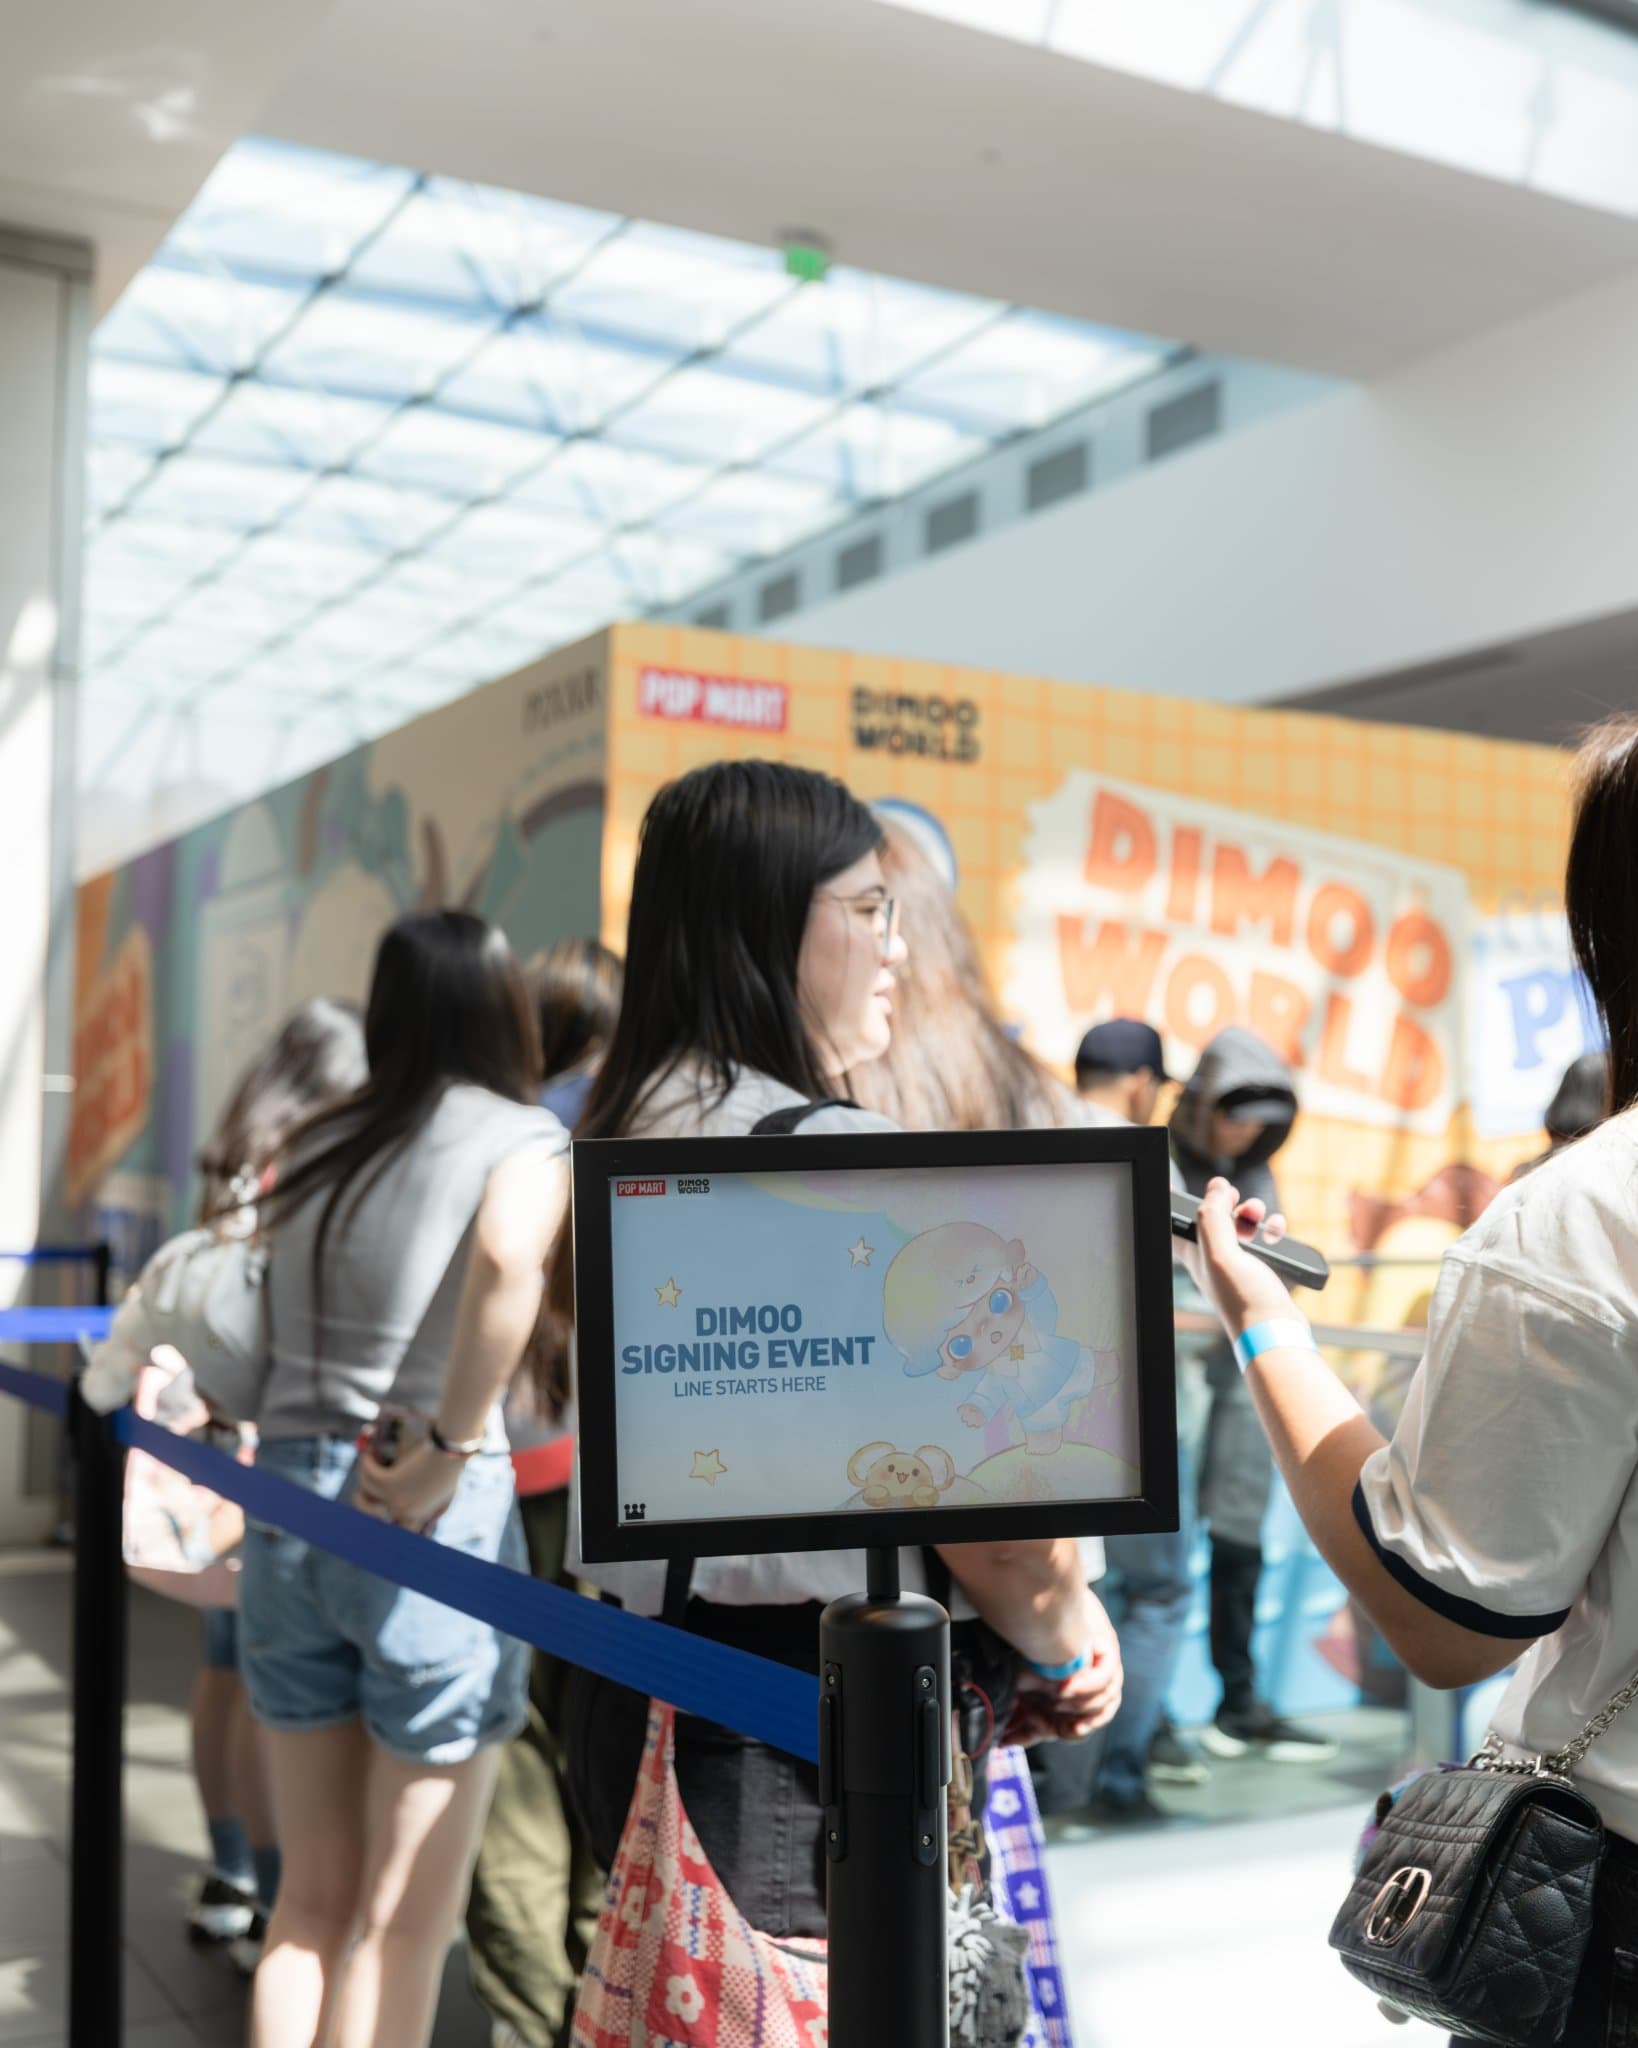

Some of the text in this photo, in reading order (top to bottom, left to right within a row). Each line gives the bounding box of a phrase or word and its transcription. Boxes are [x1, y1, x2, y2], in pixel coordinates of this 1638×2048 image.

[643, 668, 784, 729] POP MART
[853, 686, 978, 726] DIMOO
[855, 725, 980, 763] WORLD
[1083, 788, 1452, 1009] DIMOO
[618, 1182, 664, 1194] POP MART
[678, 1186, 710, 1194] WORLD
[695, 1304, 802, 1337] DIMOO
[621, 1336, 876, 1375] SIGNING EVENT
[674, 1376, 826, 1397] LINE STARTS HERE
